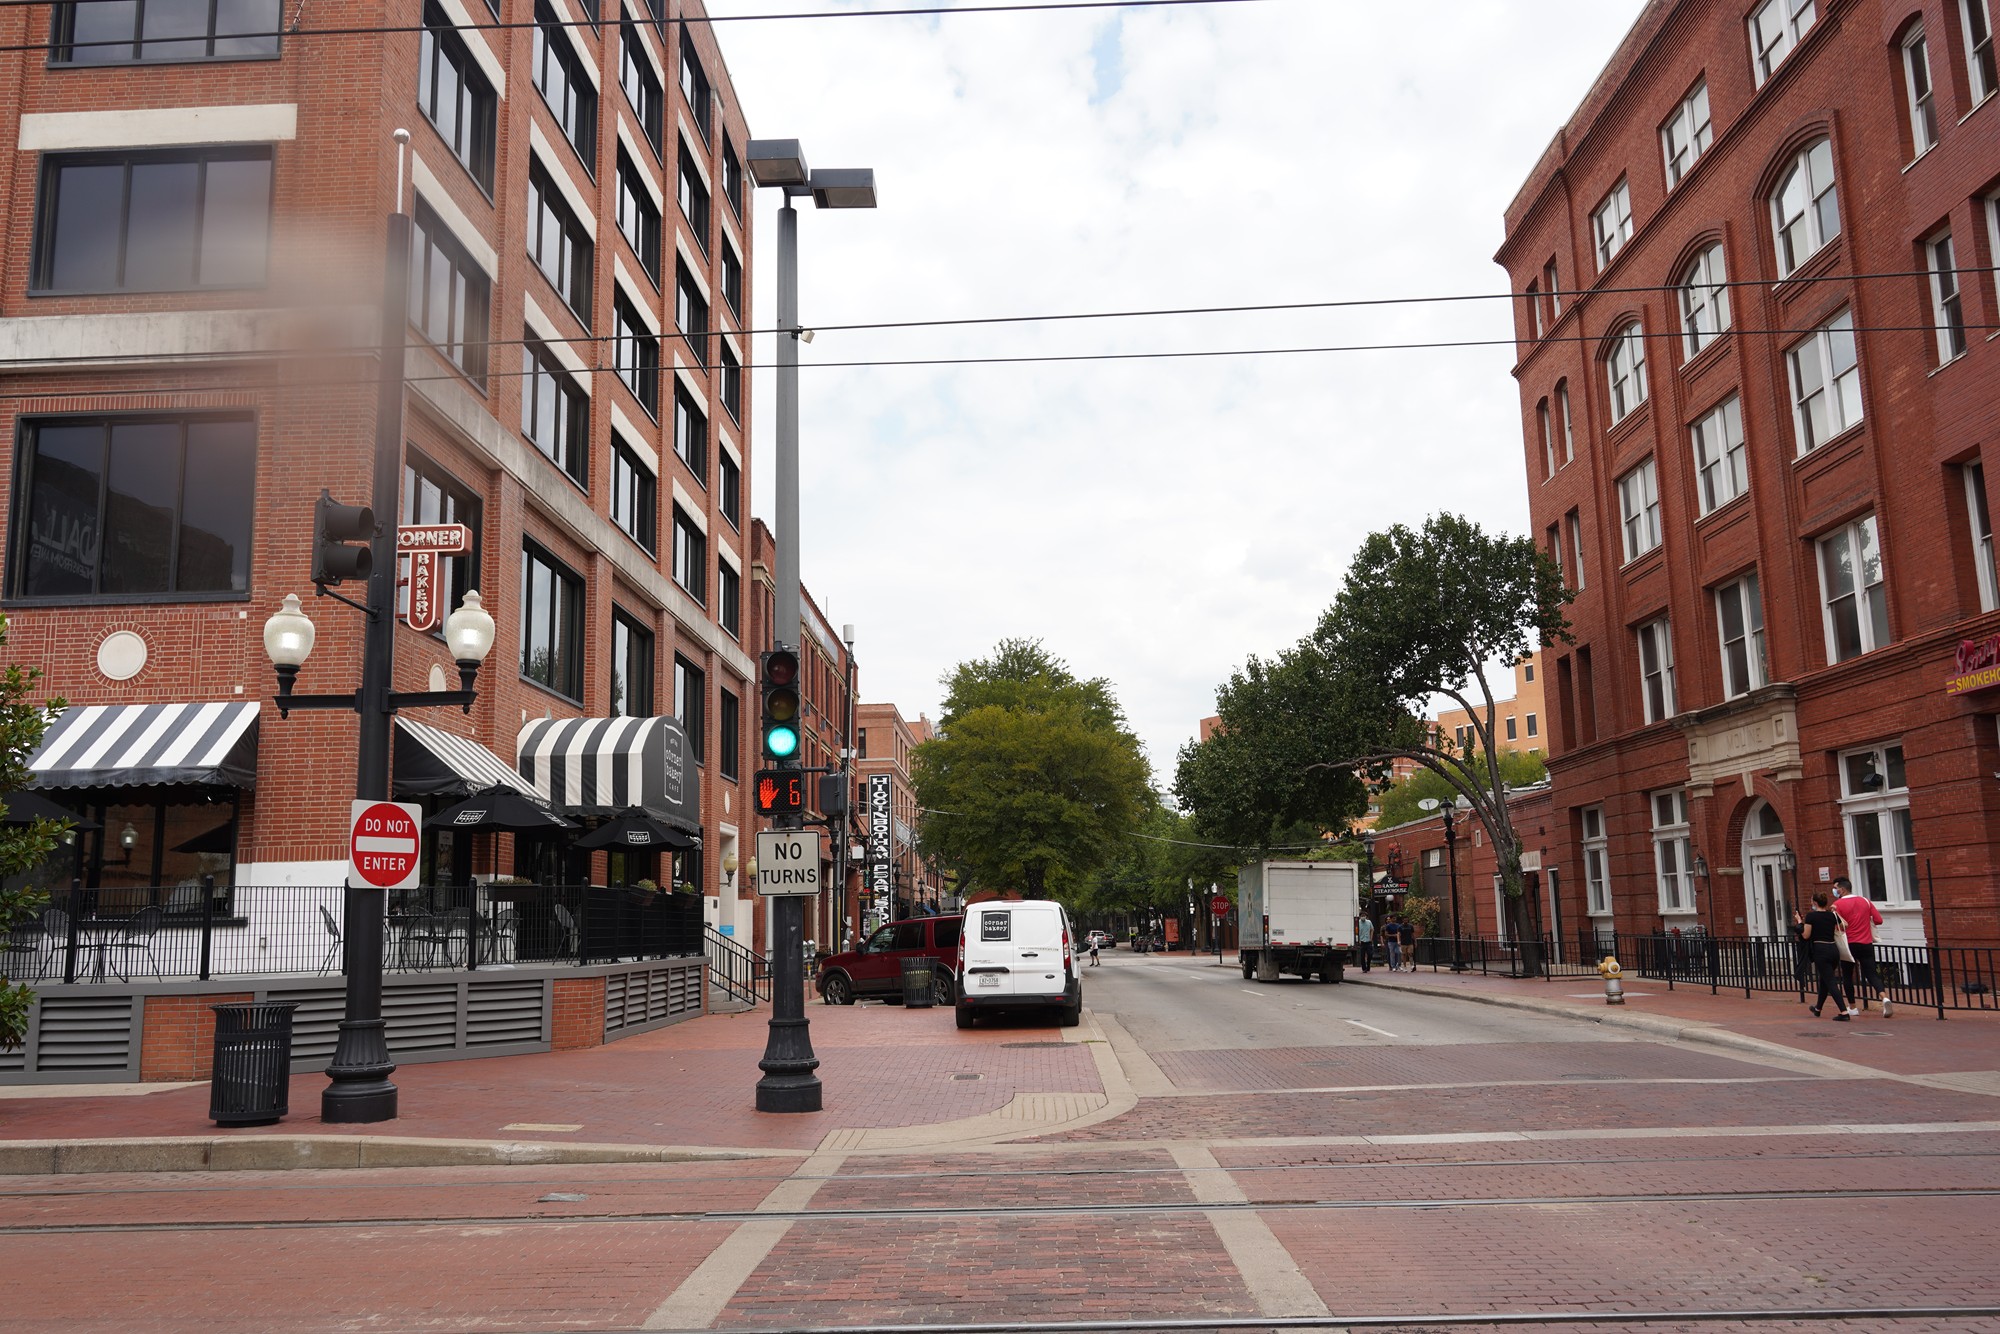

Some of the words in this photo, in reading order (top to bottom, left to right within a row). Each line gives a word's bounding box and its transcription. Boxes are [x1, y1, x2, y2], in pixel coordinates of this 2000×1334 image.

[397, 530, 462, 546] ORNER
[415, 553, 430, 623] BAKERY
[789, 779, 800, 805] 6
[365, 818, 381, 832] DO
[386, 819, 410, 833] NOT
[775, 842, 802, 860] NO
[363, 856, 406, 871] ENTER
[760, 868, 817, 884] TURNS
[1211, 901, 1229, 910] STOP
